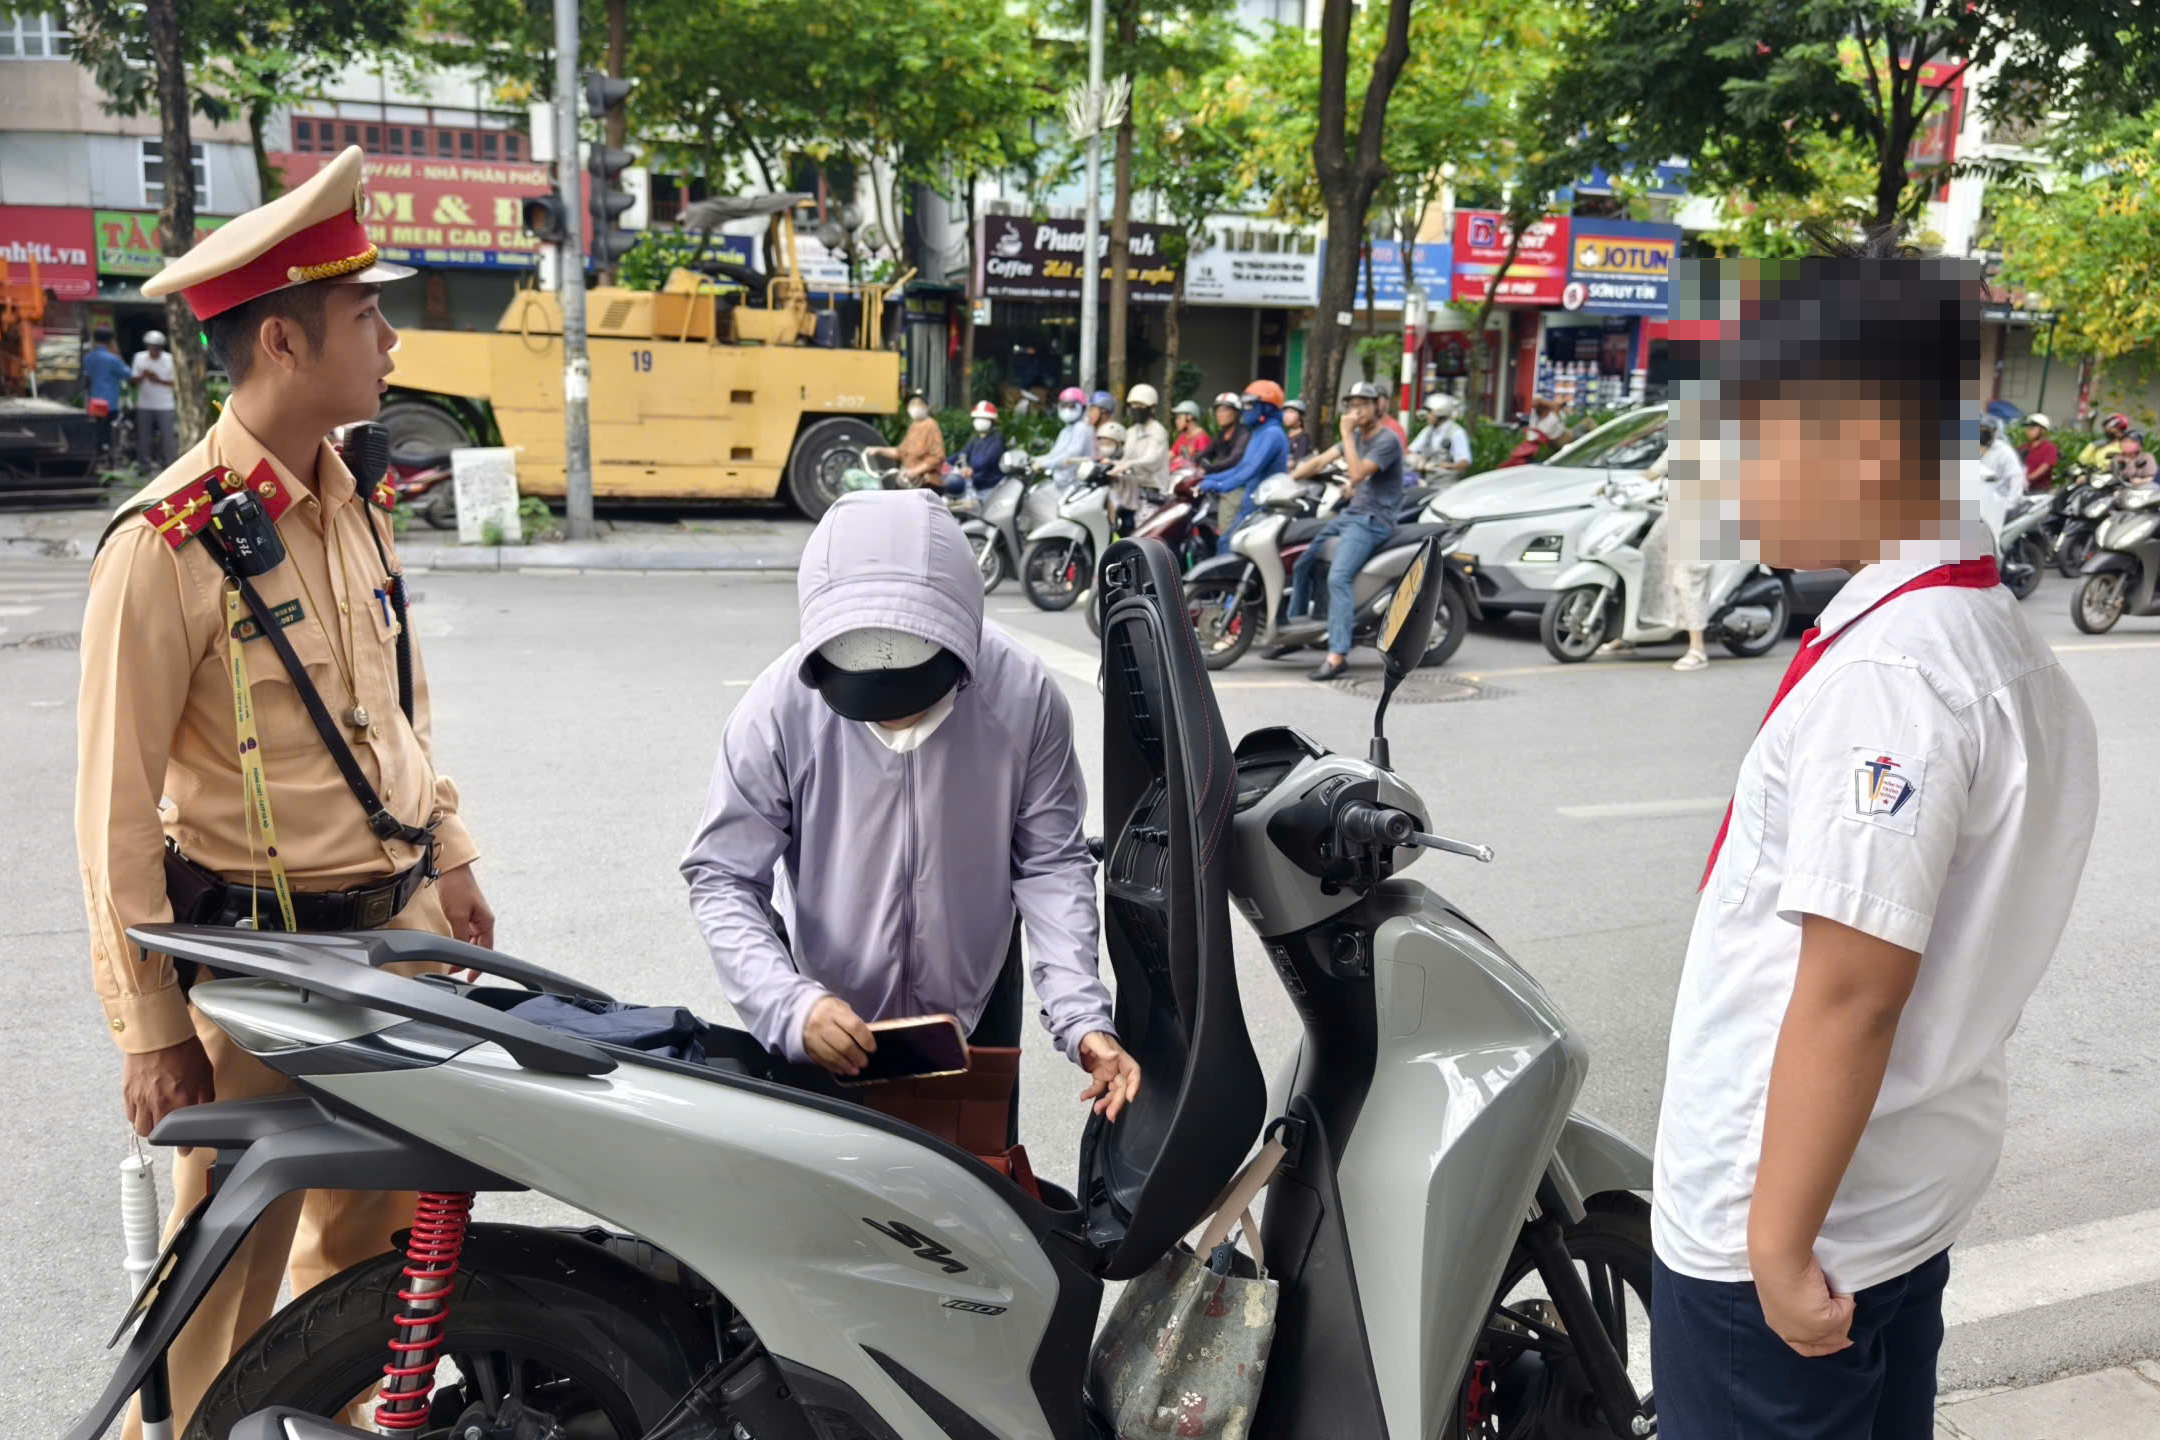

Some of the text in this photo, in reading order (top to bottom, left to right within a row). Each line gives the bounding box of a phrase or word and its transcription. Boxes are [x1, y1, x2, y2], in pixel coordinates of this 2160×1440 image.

[433, 194, 476, 225] &
[391, 226, 442, 246] MEN
[449, 228, 493, 247] CAO
[1034, 225, 1109, 258] Phươg
[986, 257, 1034, 279] Coffee
[1600, 247, 1668, 270] JOTUN
[632, 349, 652, 373] 19
